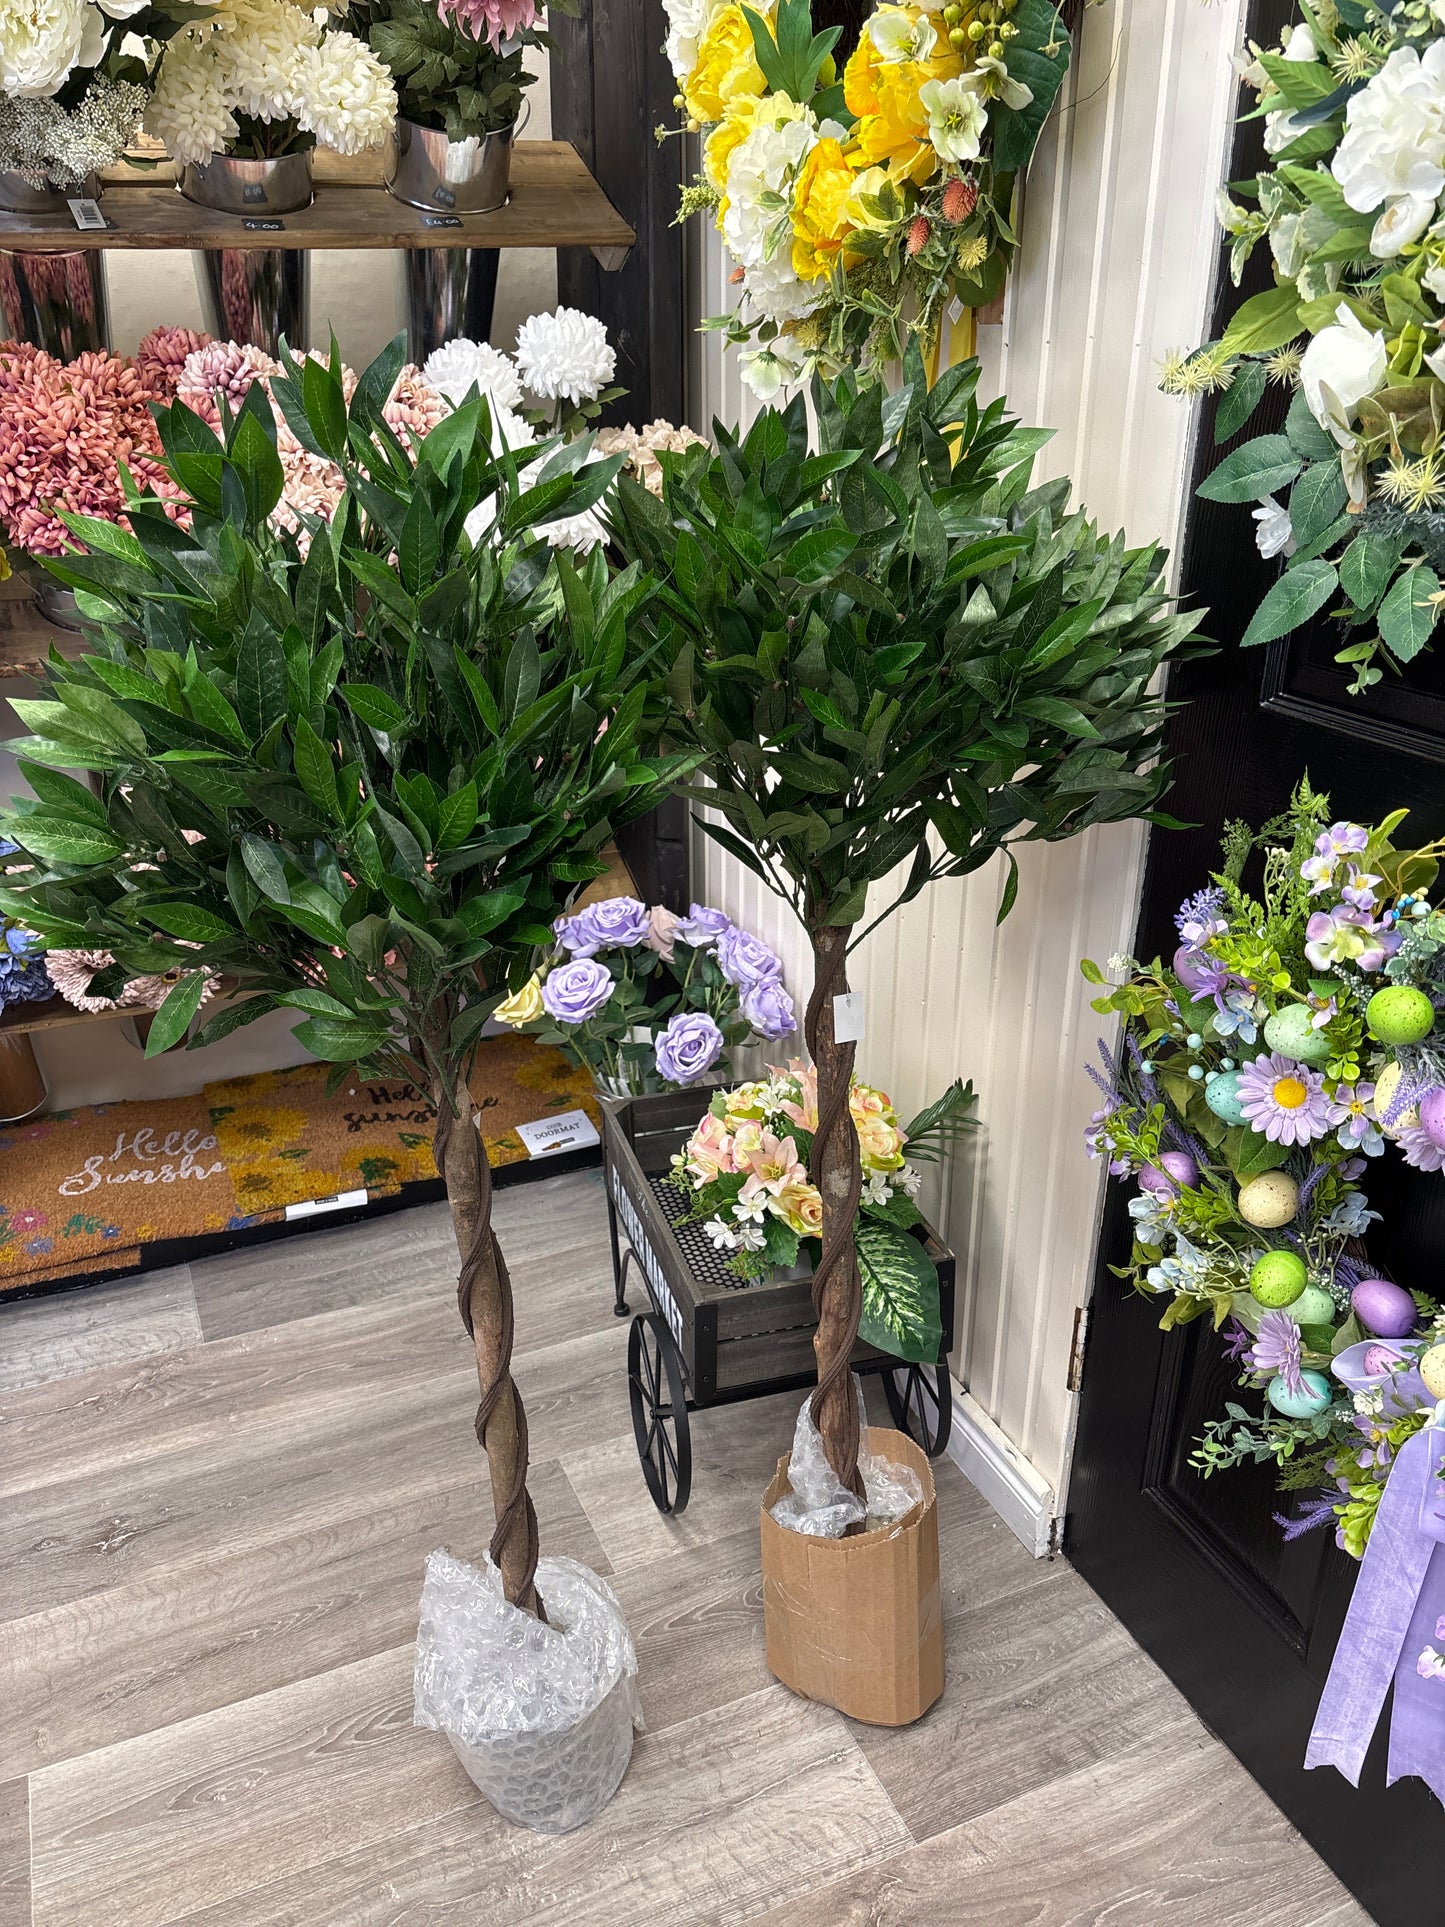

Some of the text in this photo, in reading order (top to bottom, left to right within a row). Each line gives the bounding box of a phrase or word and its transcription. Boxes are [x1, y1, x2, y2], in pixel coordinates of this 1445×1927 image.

[109, 1127, 217, 1162] Hello
[534, 1122, 581, 1140] DOORMAT
[612, 1163, 683, 1354] FLOWER MARKET
